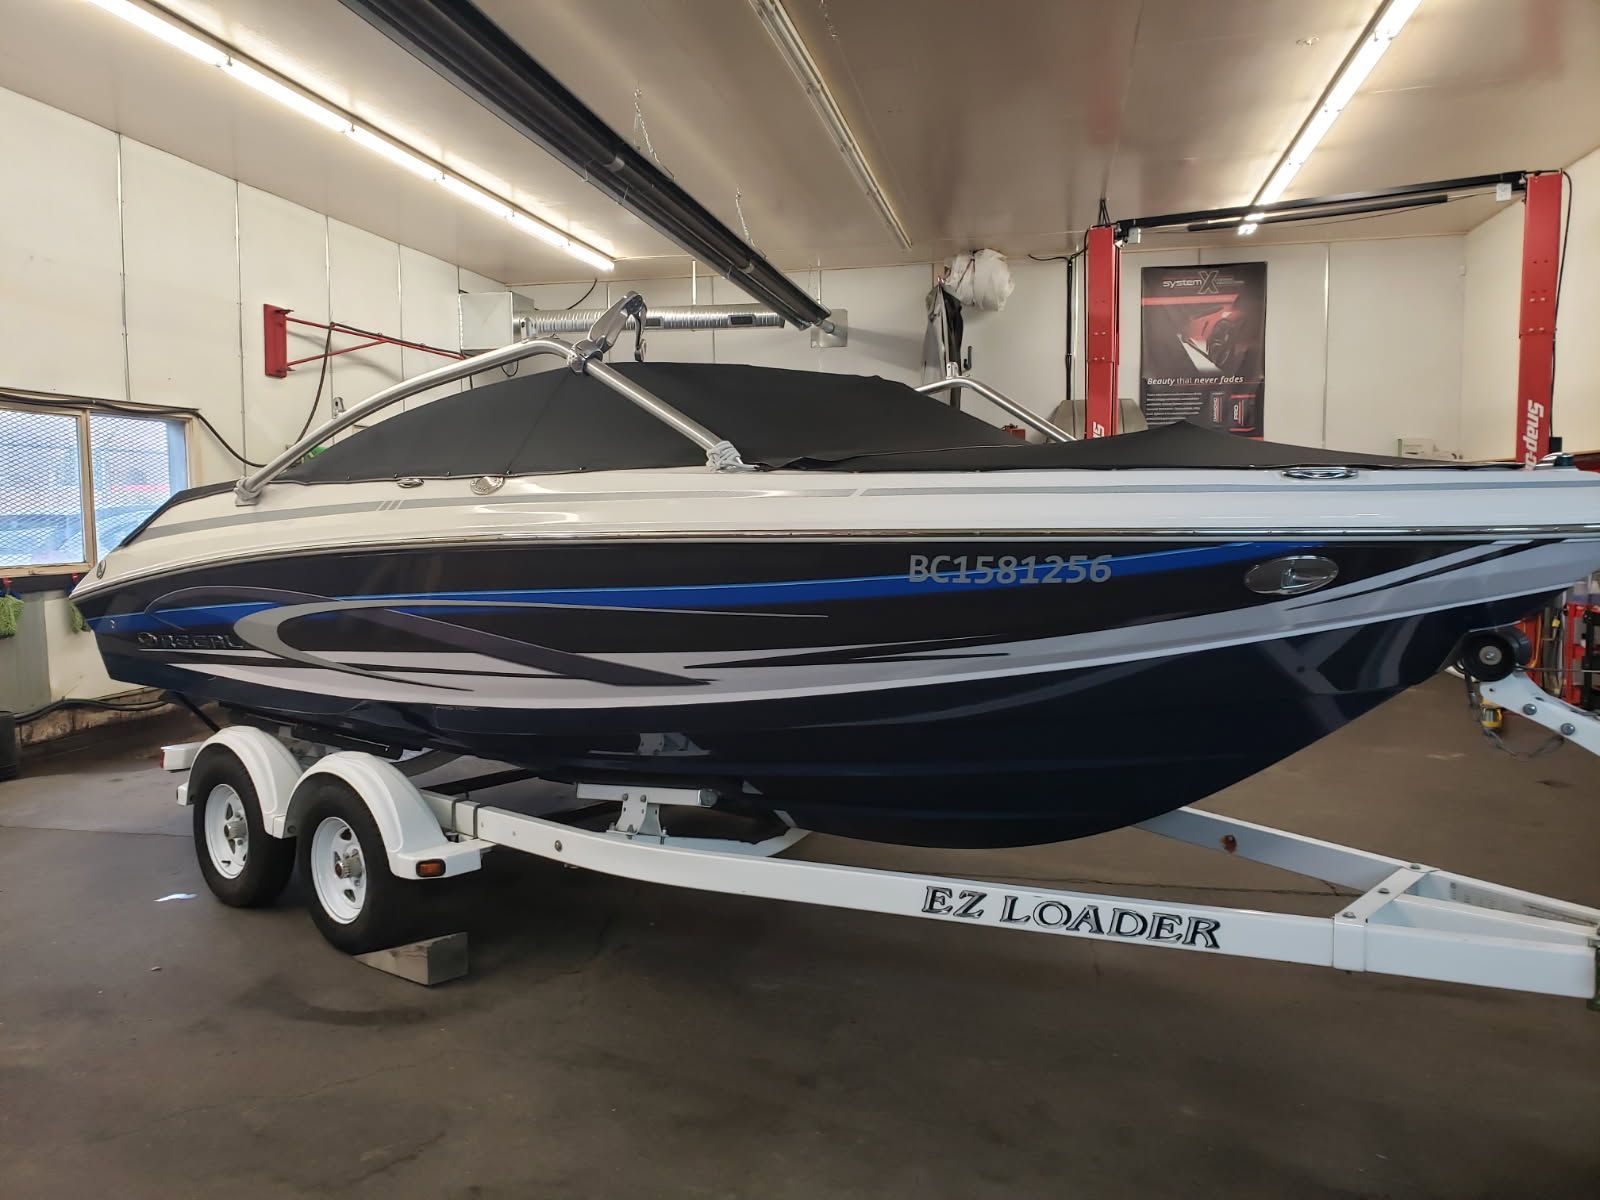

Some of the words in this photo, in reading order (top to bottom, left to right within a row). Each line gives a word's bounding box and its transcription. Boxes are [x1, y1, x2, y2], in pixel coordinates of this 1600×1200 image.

[1147, 377, 1175, 387] Beauty
[1194, 377, 1218, 385] never
[1218, 375, 1244, 386] fades
[908, 554, 1113, 585] BC1581256
[921, 885, 988, 920] EZ
[998, 895, 1222, 950] LOADER
